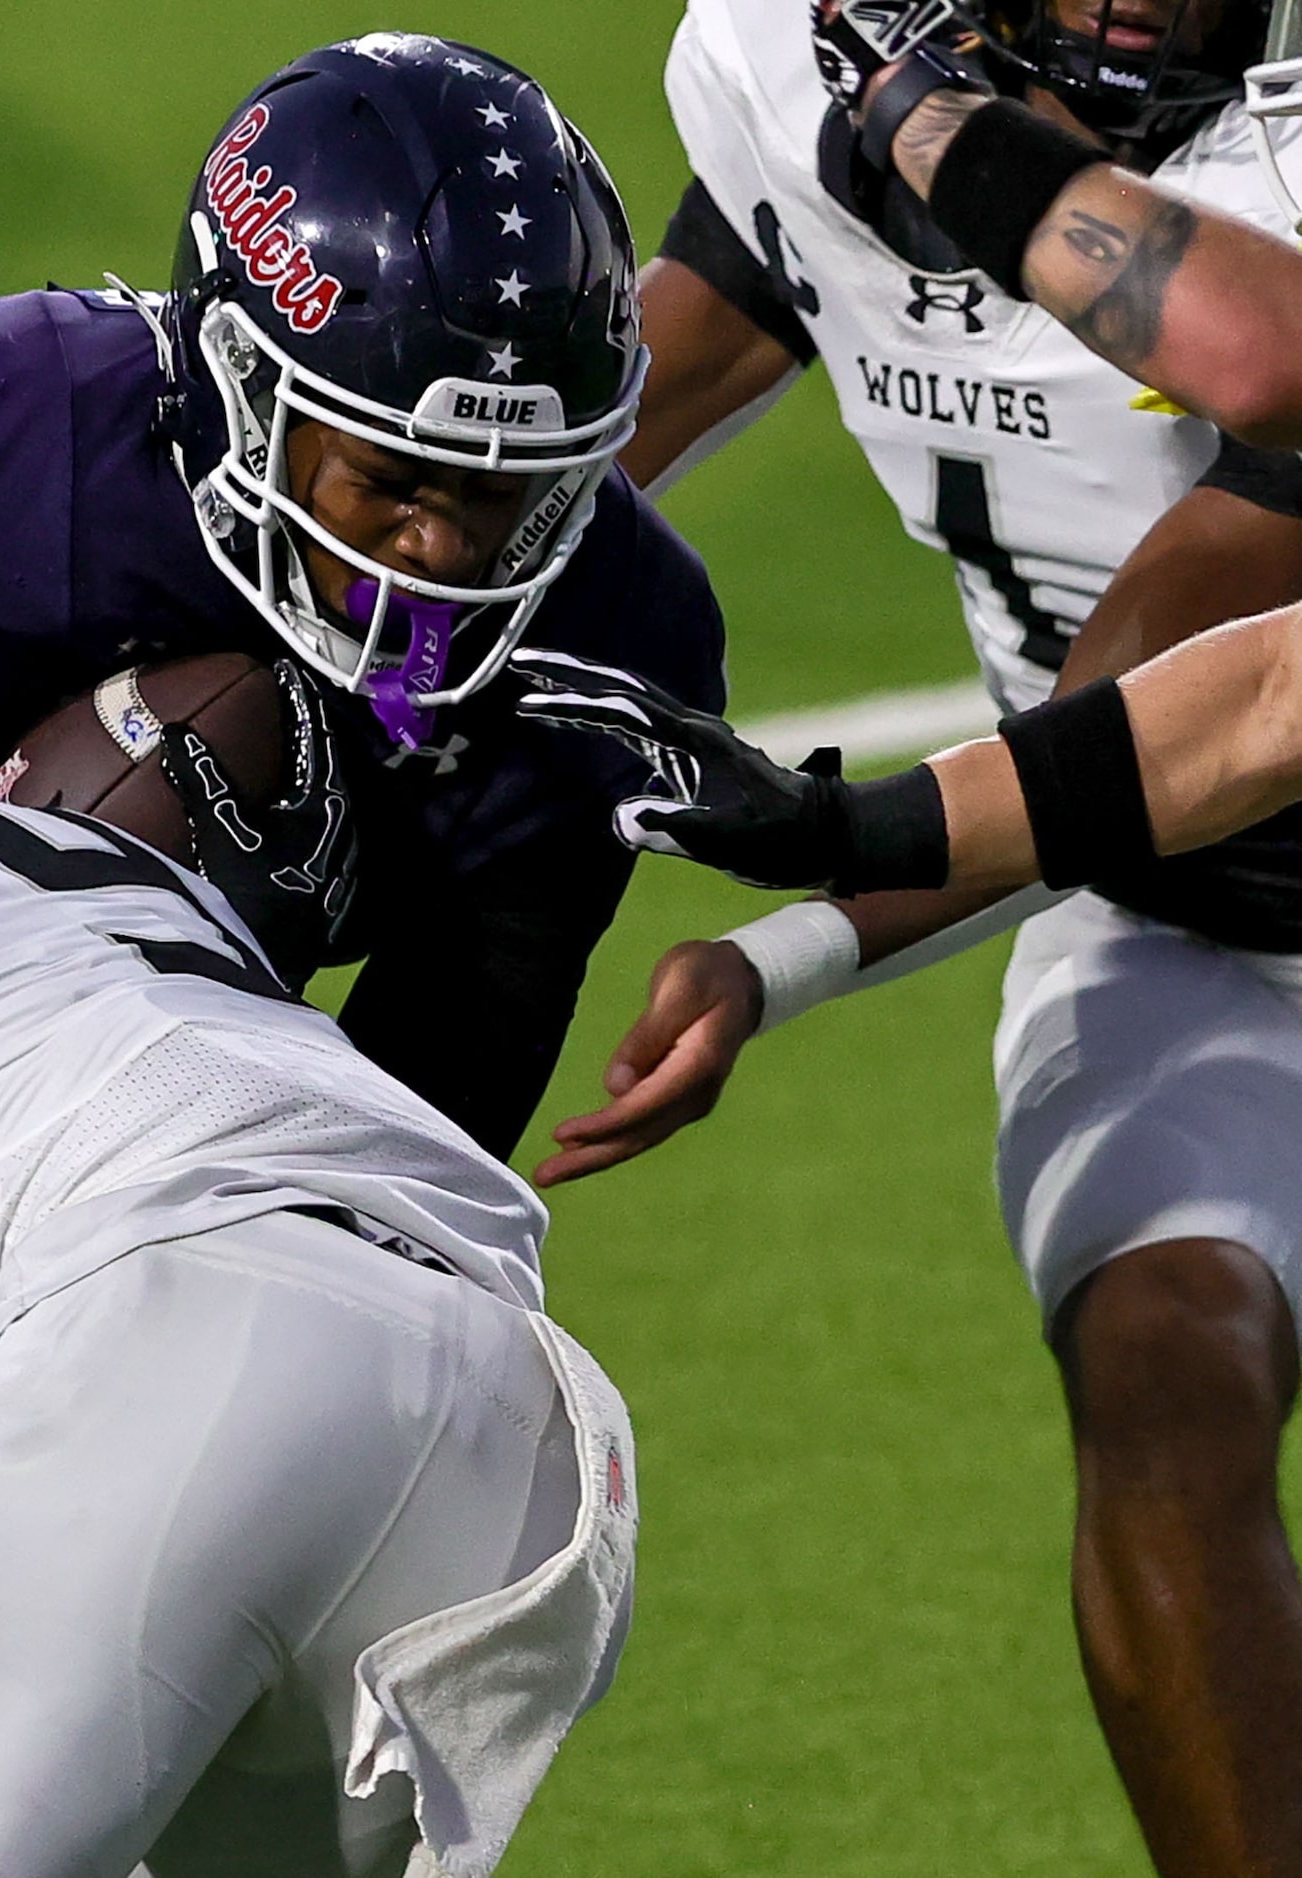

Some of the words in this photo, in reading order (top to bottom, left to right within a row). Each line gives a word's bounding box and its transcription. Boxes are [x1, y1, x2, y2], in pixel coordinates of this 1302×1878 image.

[204, 102, 343, 336] Raiders
[453, 394, 537, 426] BLUE
[855, 356, 1052, 440] WOLVES
[501, 486, 570, 571] Riddell
